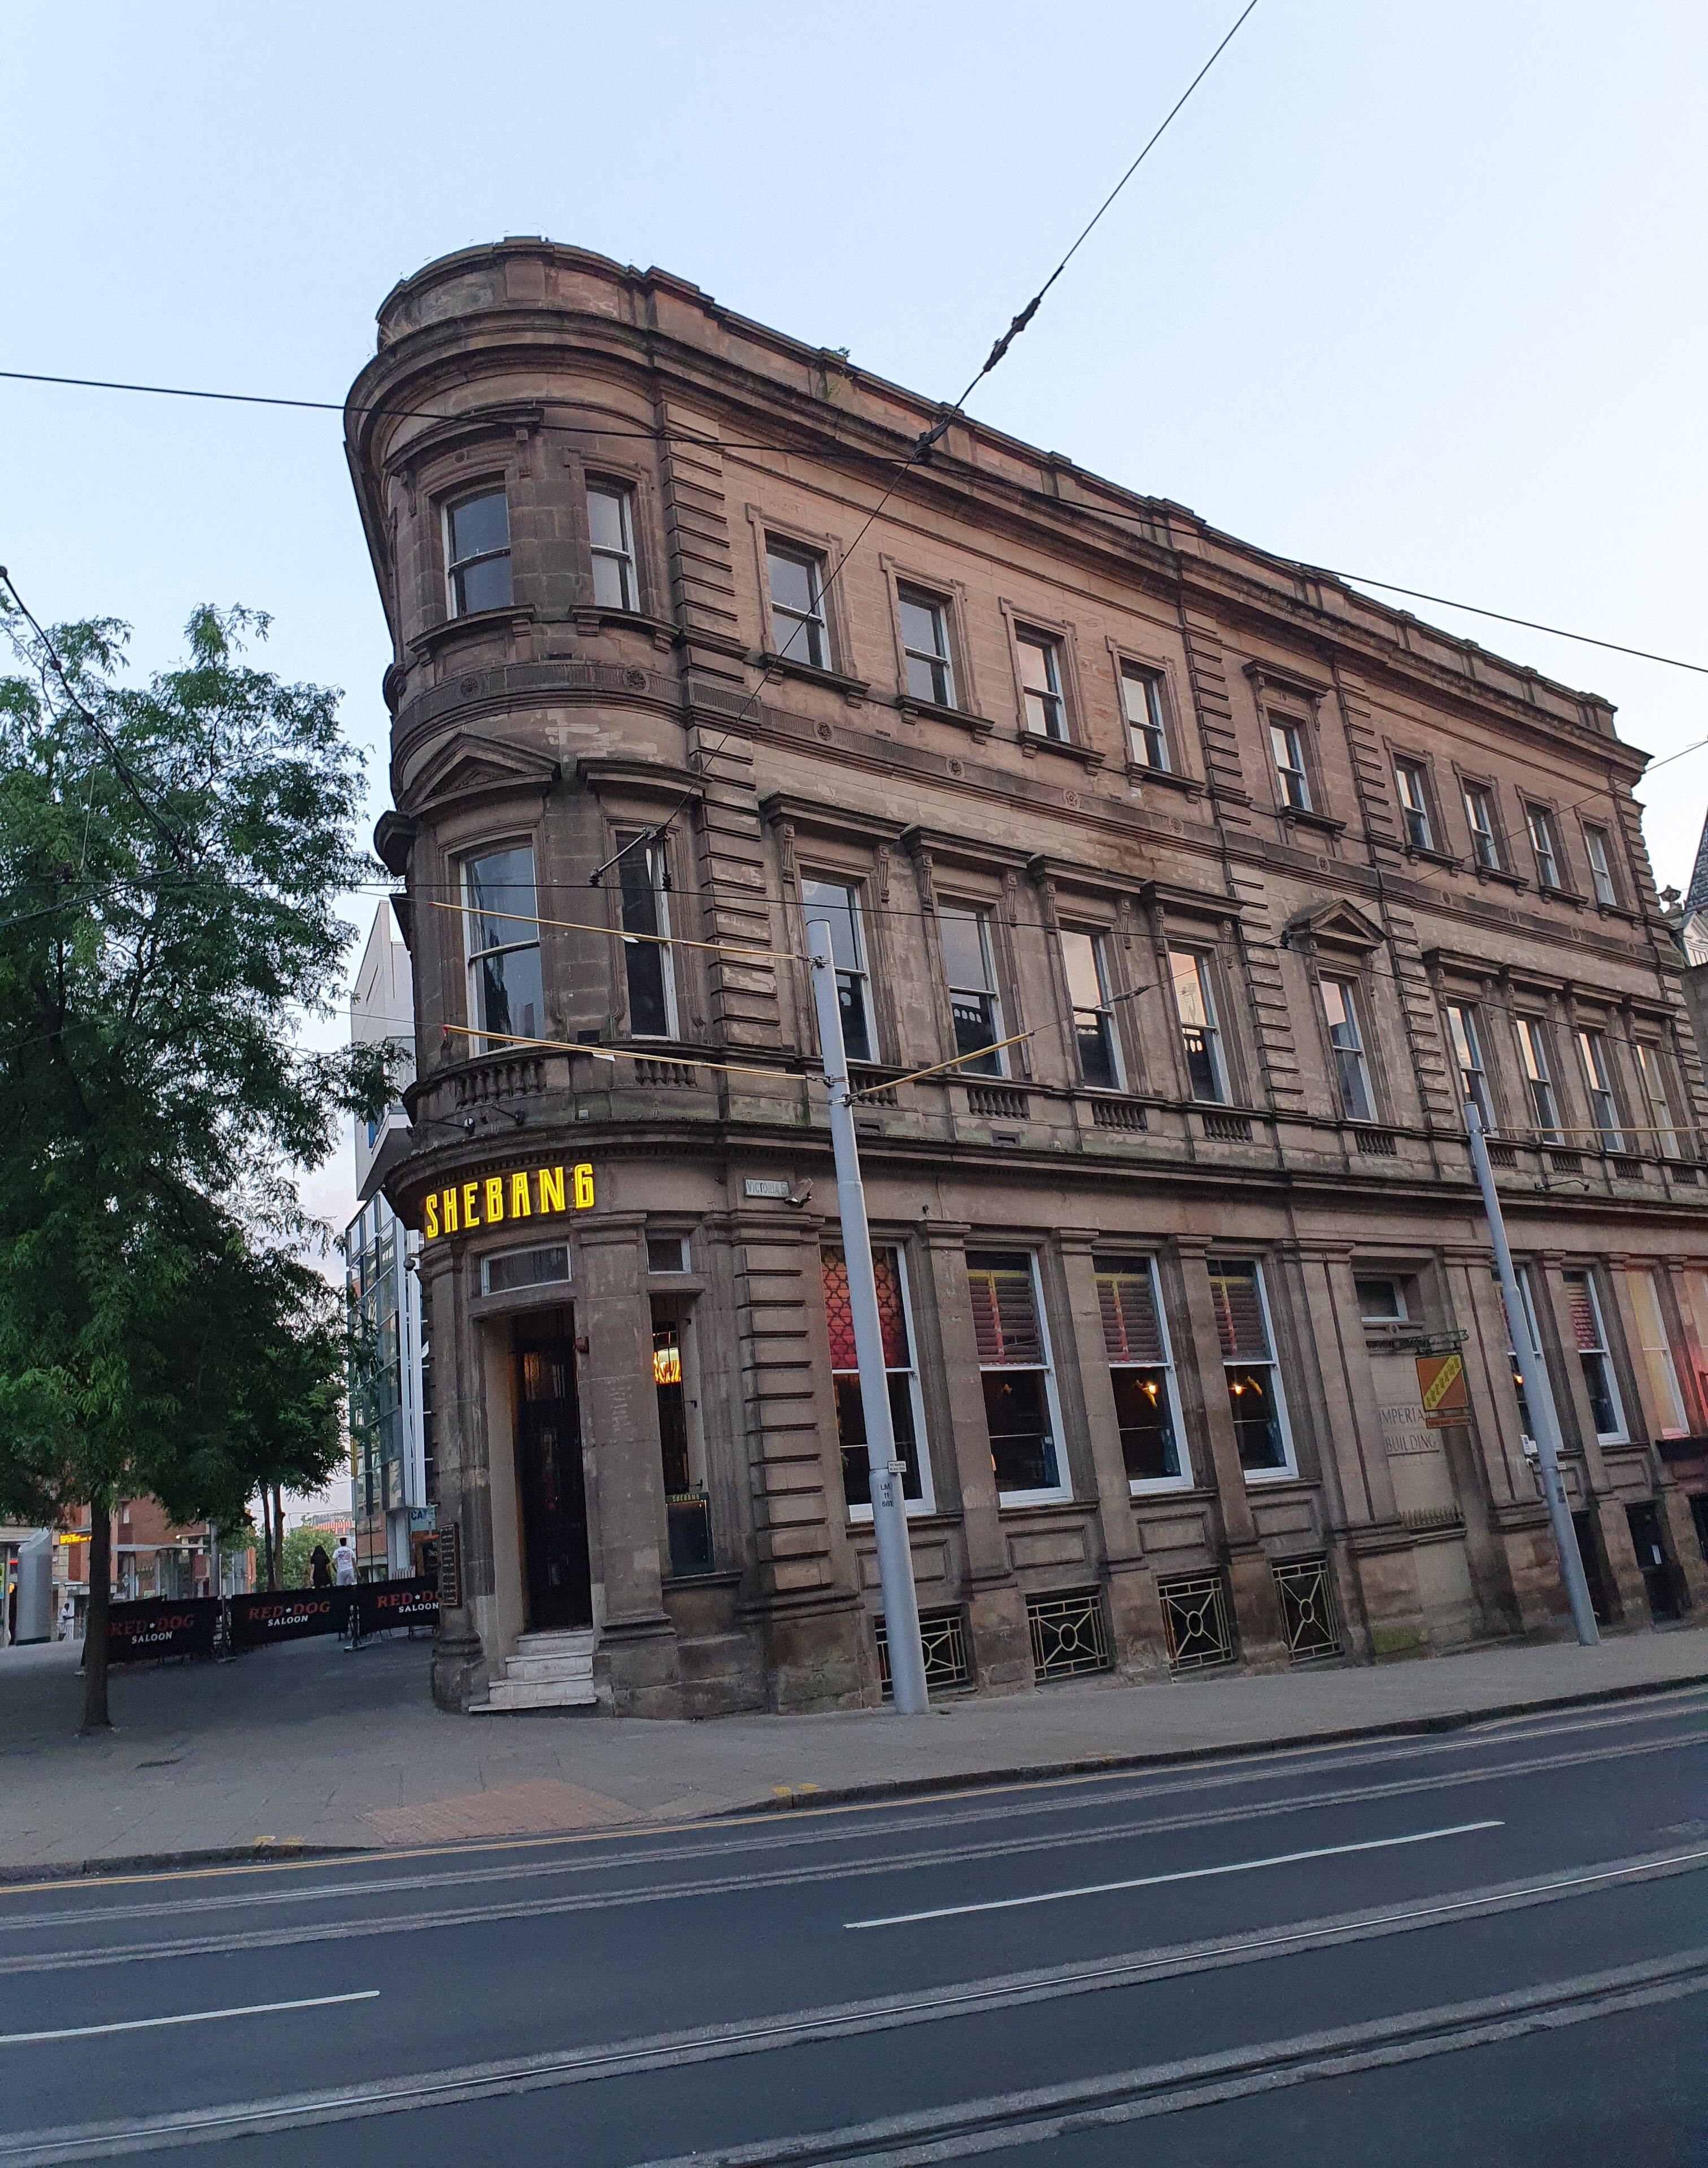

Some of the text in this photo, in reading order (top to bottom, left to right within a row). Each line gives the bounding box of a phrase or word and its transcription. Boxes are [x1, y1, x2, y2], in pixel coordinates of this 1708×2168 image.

[426, 1163, 594, 1238] SHEBANG
[1385, 1433, 1437, 1452] BUILDING
[376, 1592, 413, 1608] RED
[398, 1602, 439, 1613] SALOON
[249, 1601, 330, 1620] RED DOG
[156, 1614, 195, 1631] DOG
[268, 1615, 308, 1627] SALOON
[132, 1631, 173, 1644] SALOON
